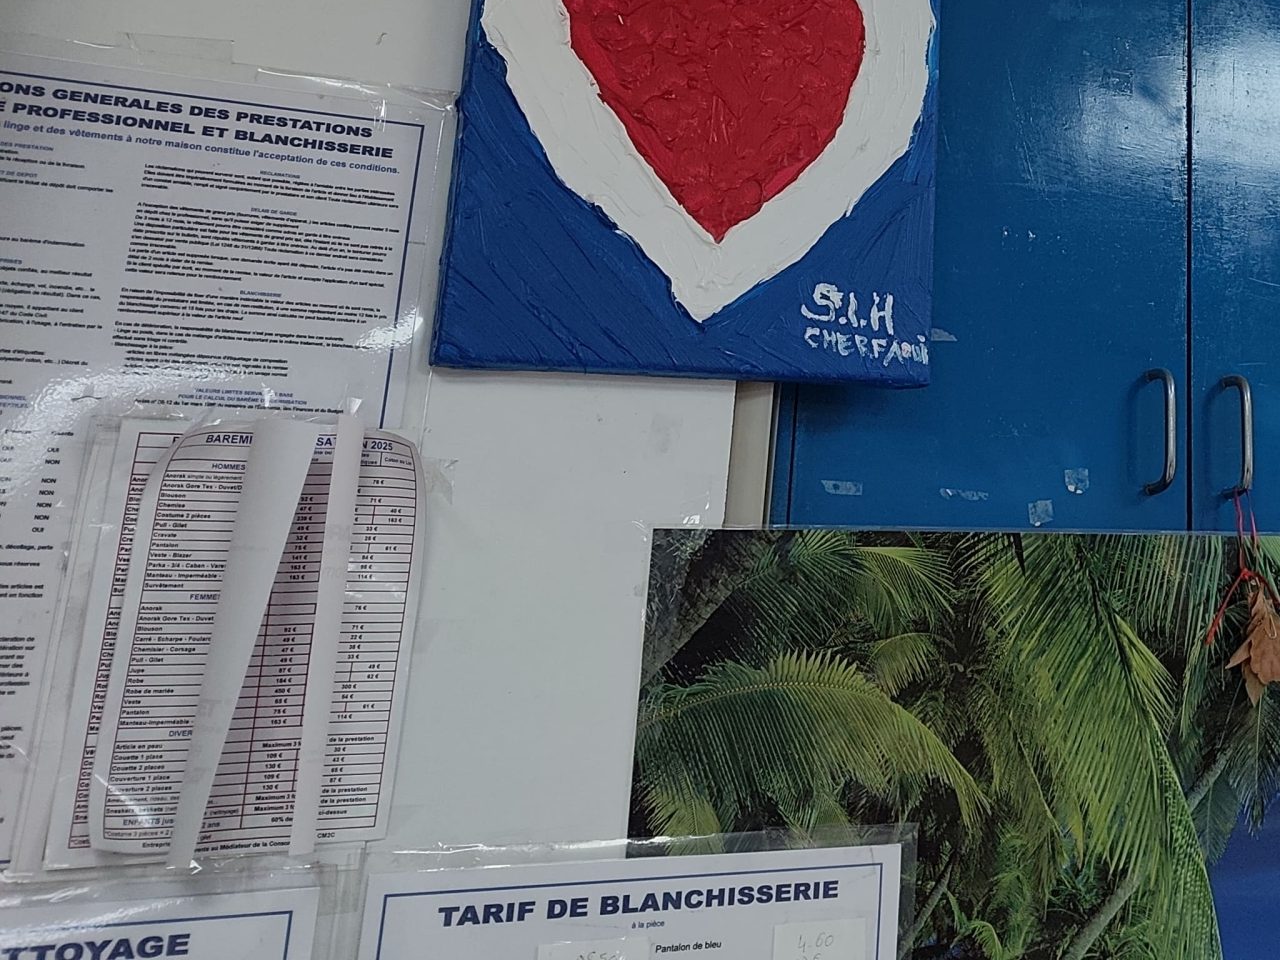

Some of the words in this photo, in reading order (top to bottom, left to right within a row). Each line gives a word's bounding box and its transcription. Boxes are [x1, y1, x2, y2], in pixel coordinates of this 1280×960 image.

[12, 102, 195, 134] PROFESSIONNEL
[201, 125, 229, 138] ET
[234, 129, 394, 158] BLANCHISSERIE
[52, 88, 183, 114] GENERALES
[188, 105, 230, 120] DES
[235, 111, 373, 138] PRESTATIONS
[3, 120, 30, 132] linge
[33, 124, 43, 133] et
[46, 125, 65, 135] des
[69, 127, 123, 142] vêtements
[126, 134, 132, 143] à
[135, 136, 162, 146] notre
[165, 140, 202, 151] maison
[205, 145, 251, 157] constitue
[252, 150, 313, 165] l'acceptation
[316, 157, 328, 166] de
[330, 159, 346, 168] ces
[349, 161, 400, 175] conditions.
[205, 434, 253, 445] BAREM
[371, 441, 393, 451] 2025
[211, 463, 246, 471] HOMMES
[438, 900, 536, 927] TARIF
[546, 897, 589, 920] DE
[600, 880, 839, 915] BLANCHISSERIE
[655, 943, 690, 954] Pantalon
[694, 942, 703, 951] de
[705, 940, 722, 950] bleu
